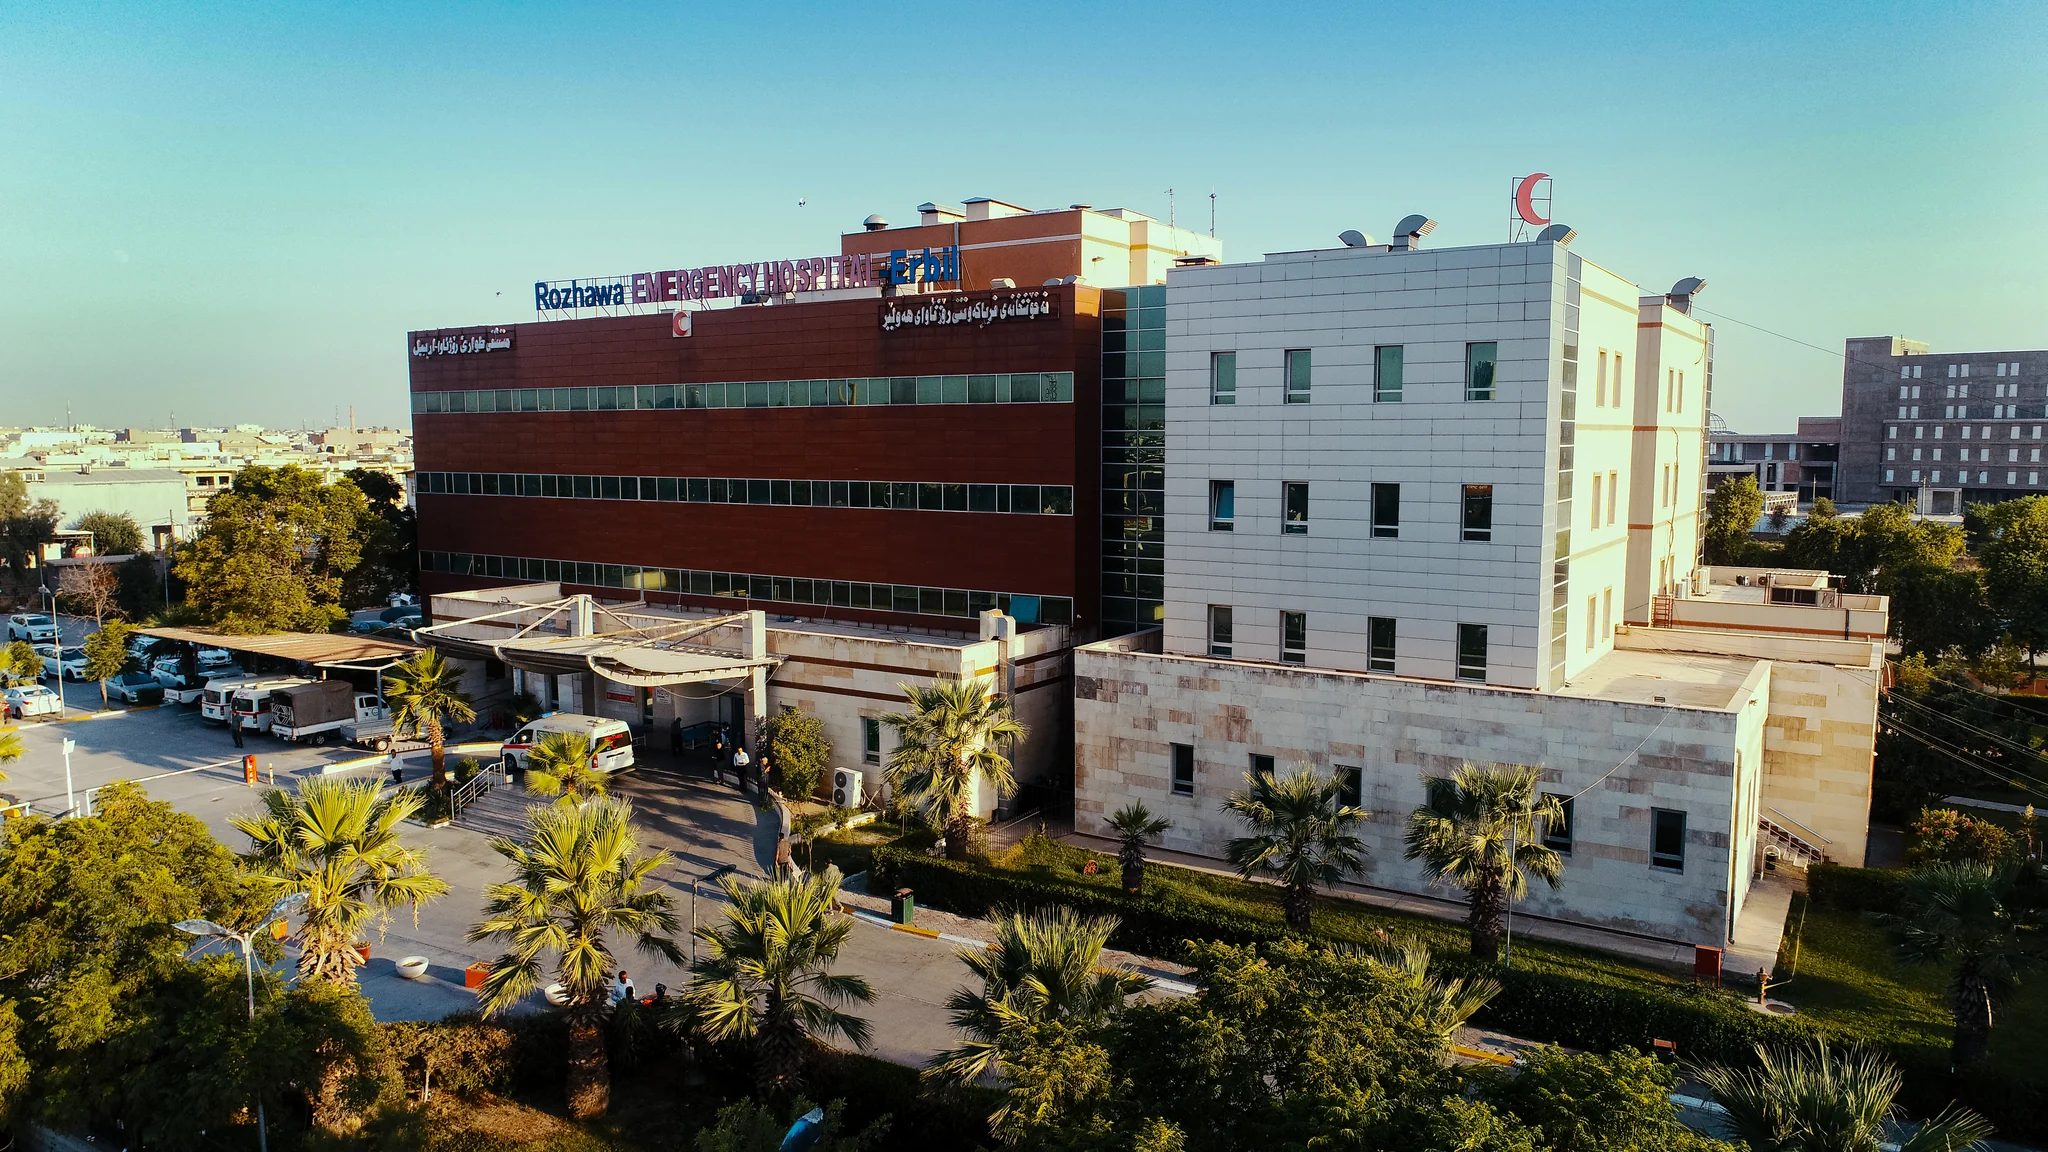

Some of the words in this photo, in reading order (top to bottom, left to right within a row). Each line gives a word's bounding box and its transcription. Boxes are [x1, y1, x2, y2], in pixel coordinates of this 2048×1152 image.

[535, 280, 625, 310] Rozhawa
[632, 262, 758, 304] EMERGENCY
[763, 253, 880, 294] HOSPITAL
